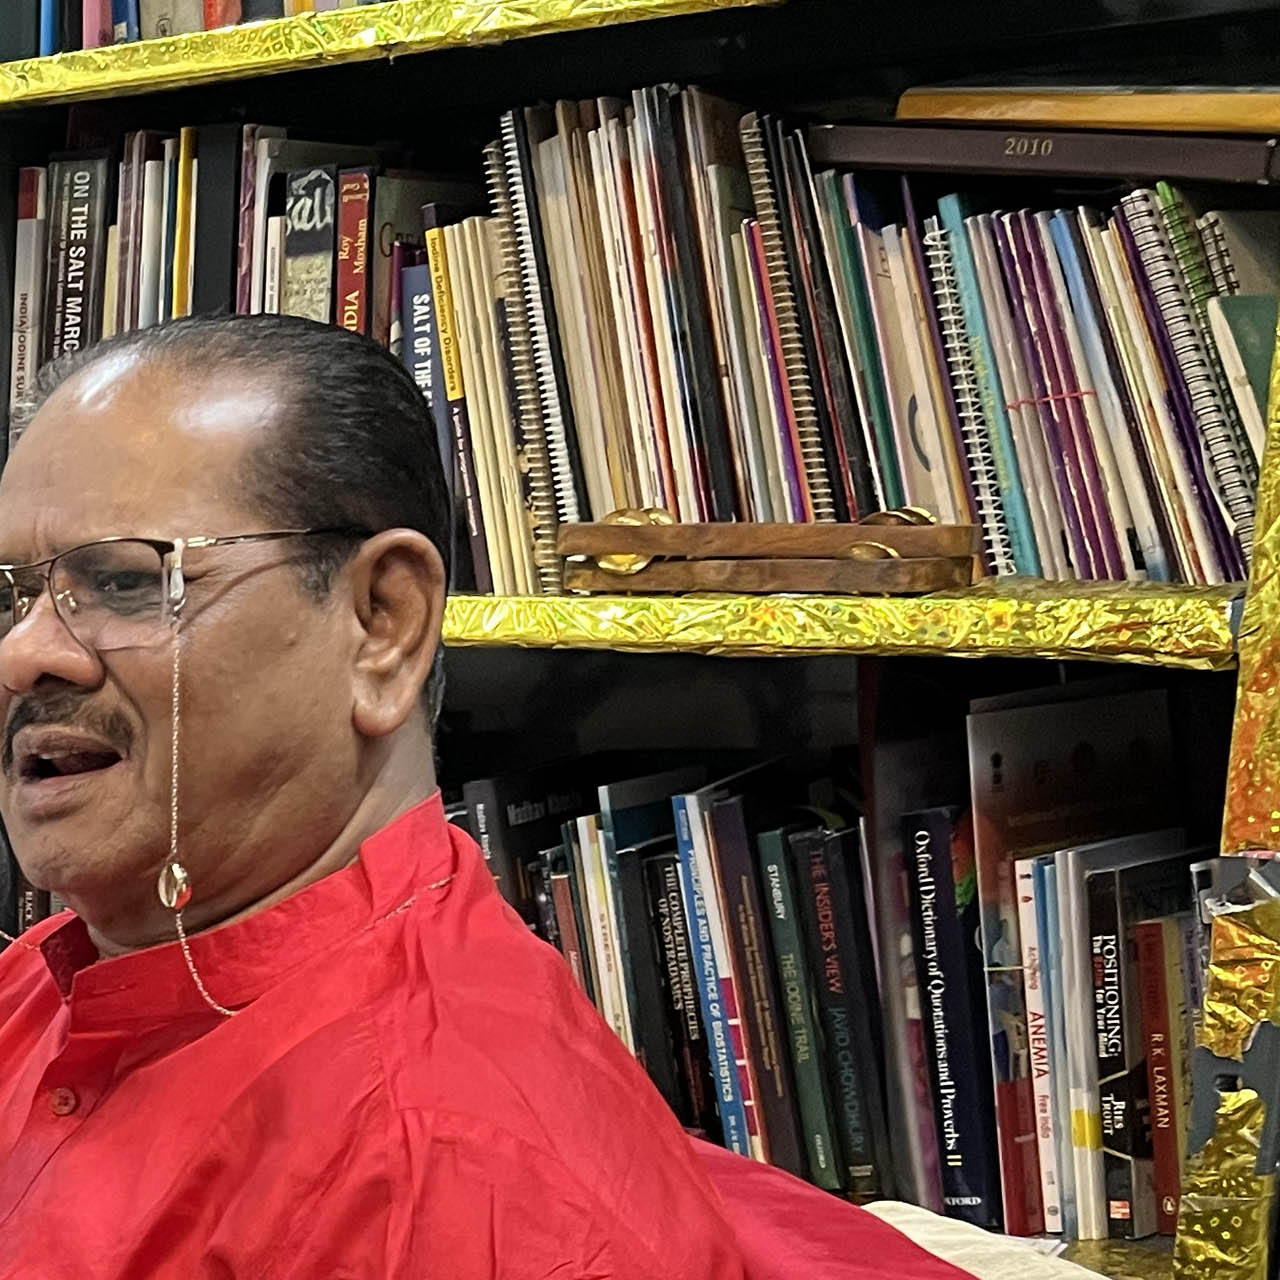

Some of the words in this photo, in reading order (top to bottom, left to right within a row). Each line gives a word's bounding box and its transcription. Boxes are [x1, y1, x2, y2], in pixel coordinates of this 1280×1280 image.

[1004, 136, 1054, 156] 2010
[74, 170, 91, 199] ON
[70, 203, 89, 241] THE
[338, 234, 355, 261] Roy
[353, 218, 368, 275] Moxham
[430, 237, 440, 272] Iodine
[67, 246, 86, 291] SALT
[64, 296, 83, 351] MARC
[412, 293, 430, 334] SALT
[434, 275, 448, 338] Deficiency
[413, 336, 432, 357] OF
[443, 337, 457, 392] Disorders
[414, 359, 432, 388] THE
[809, 848, 825, 879] THE
[914, 829, 931, 880] Oxford
[664, 866, 674, 888] THE
[689, 849, 704, 914] PRINCIPLES
[767, 864, 786, 920] STANBURY
[659, 898, 668, 913] OF
[667, 892, 683, 948] COMPLETE
[813, 883, 837, 952] INSIDER'S
[917, 880, 937, 959] Dictionary
[697, 916, 710, 943] AND
[1092, 935, 1102, 955] The
[662, 916, 684, 1011] NOSTRADAMUS
[701, 944, 718, 1001] PRACTICE
[780, 952, 794, 979] THE
[823, 954, 843, 995] VIEW
[927, 962, 939, 978] of
[676, 950, 699, 1040] PROPHECIES
[709, 1003, 721, 1018] OF
[785, 983, 802, 1025] IODINE
[1095, 988, 1105, 1004] for
[929, 981, 950, 1060] Quotations
[1097, 1006, 1106, 1030] Your
[711, 1021, 734, 1102] BIOSTATISTICS
[791, 1026, 810, 1065] TRAIL
[1028, 1010, 1049, 1080] ANEMIA
[1098, 1032, 1108, 1058] Mind
[938, 1060, 953, 1083] and
[837, 1050, 865, 1154] CHOWDHURY
[1039, 1095, 1049, 1113] free
[1154, 1063, 1170, 1129] LAXMAN
[941, 1083, 958, 1152] Proverbs
[1040, 1116, 1050, 1139] India
